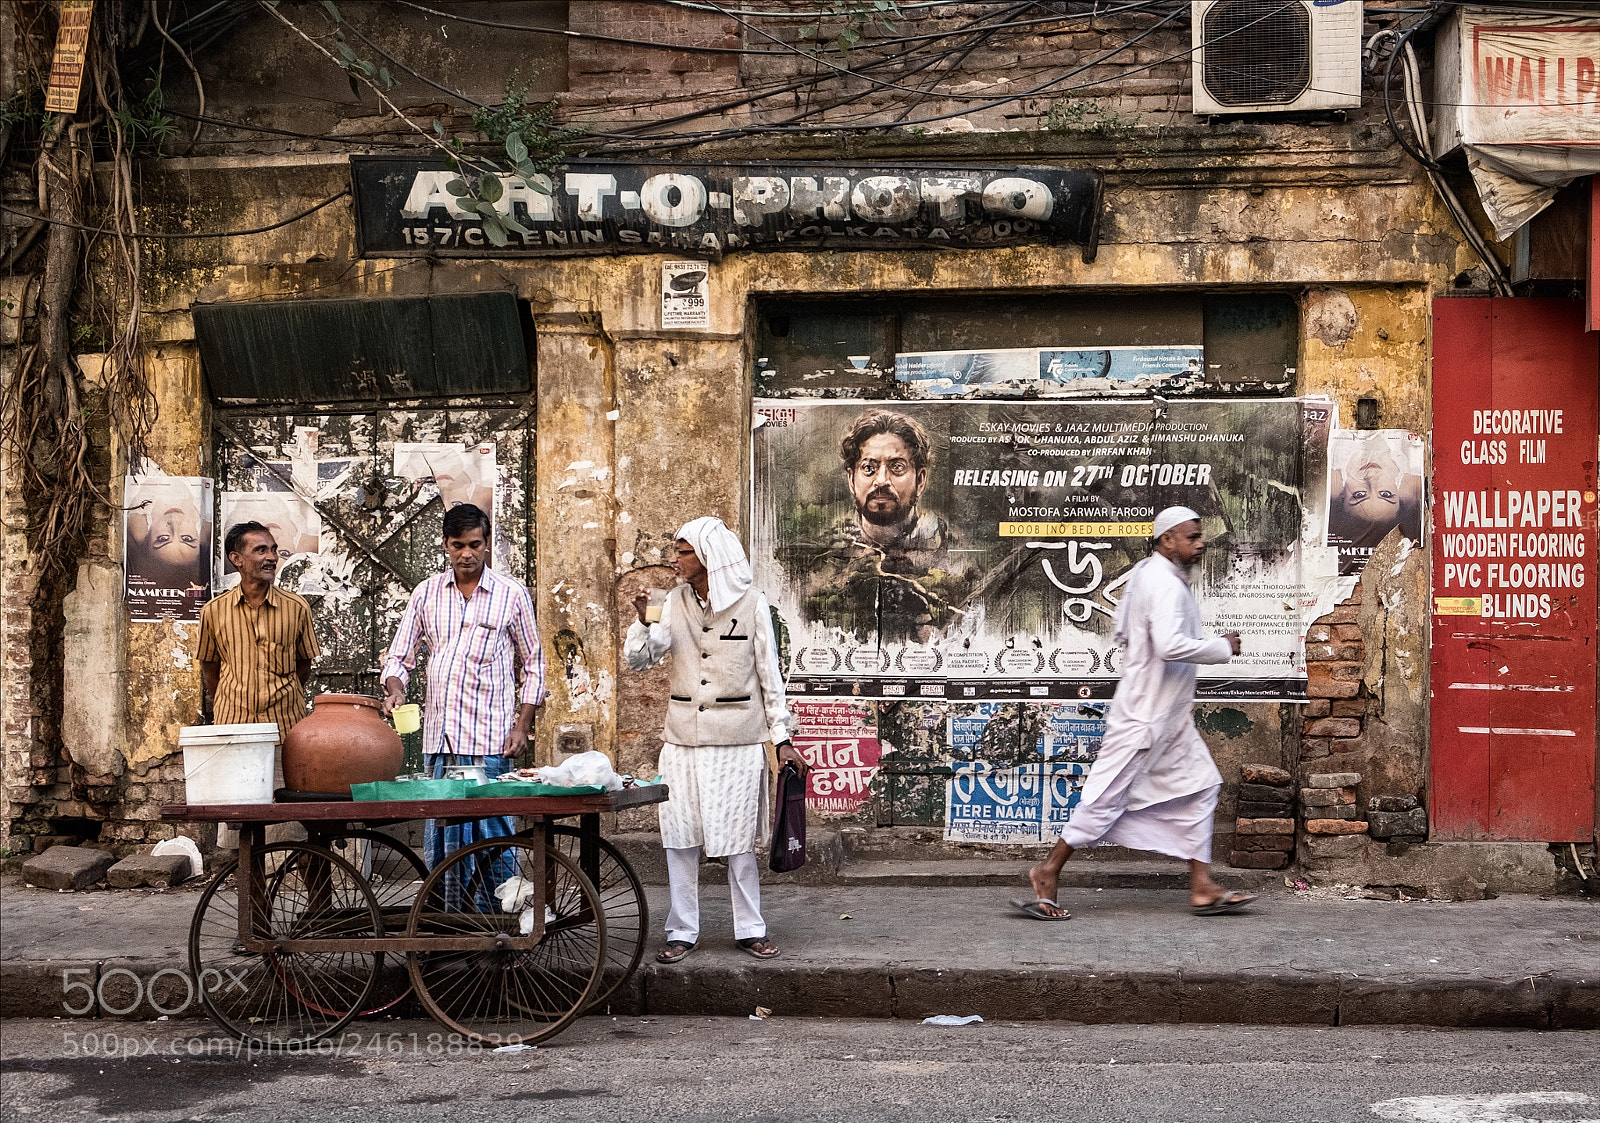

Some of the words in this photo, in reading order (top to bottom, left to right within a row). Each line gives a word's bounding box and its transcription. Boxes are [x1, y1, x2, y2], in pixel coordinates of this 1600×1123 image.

[1485, 57, 1600, 115] WALLP
[979, 423, 1008, 432] ESKAY
[1012, 423, 1050, 432] MOVIES
[1055, 424, 1062, 432] &
[1065, 423, 1090, 433] JAAZ
[1092, 423, 1154, 433] MULTIMEDIA
[1155, 423, 1208, 431] PRODUCTION
[1473, 409, 1563, 434] DECORATIVE
[999, 436, 1030, 444] ASOK
[1084, 435, 1116, 444] ABDUL
[1117, 435, 1138, 443] AZIZ
[1142, 435, 1149, 443] &
[1199, 434, 1244, 442] DHANUKA
[1092, 448, 1125, 456] IRRFAN
[1127, 447, 1152, 456] KHAN
[1460, 440, 1507, 465] GLASS
[1519, 440, 1546, 464] FILM
[953, 469, 1039, 487] RELEASING
[1043, 470, 1067, 487] ON
[1120, 463, 1212, 487] OCTOBER
[1009, 507, 1060, 517] MOSTOFA
[1063, 507, 1108, 517] SARWAR
[1443, 490, 1583, 528] WALLPAPER
[1009, 525, 1040, 534] DOOB
[1072, 525, 1093, 534] BED
[1099, 525, 1112, 534] OF
[1118, 524, 1153, 534] ROSES
[1442, 533, 1507, 558] WOODEN
[1510, 533, 1585, 558] FLOORING
[1444, 563, 1482, 588] PVC
[1487, 563, 1585, 588] FLOORING
[128, 588, 185, 598] NAMKEEN
[1481, 593, 1551, 618] BLINDS
[953, 805, 992, 817] TERE
[995, 806, 1036, 819] NAAM
